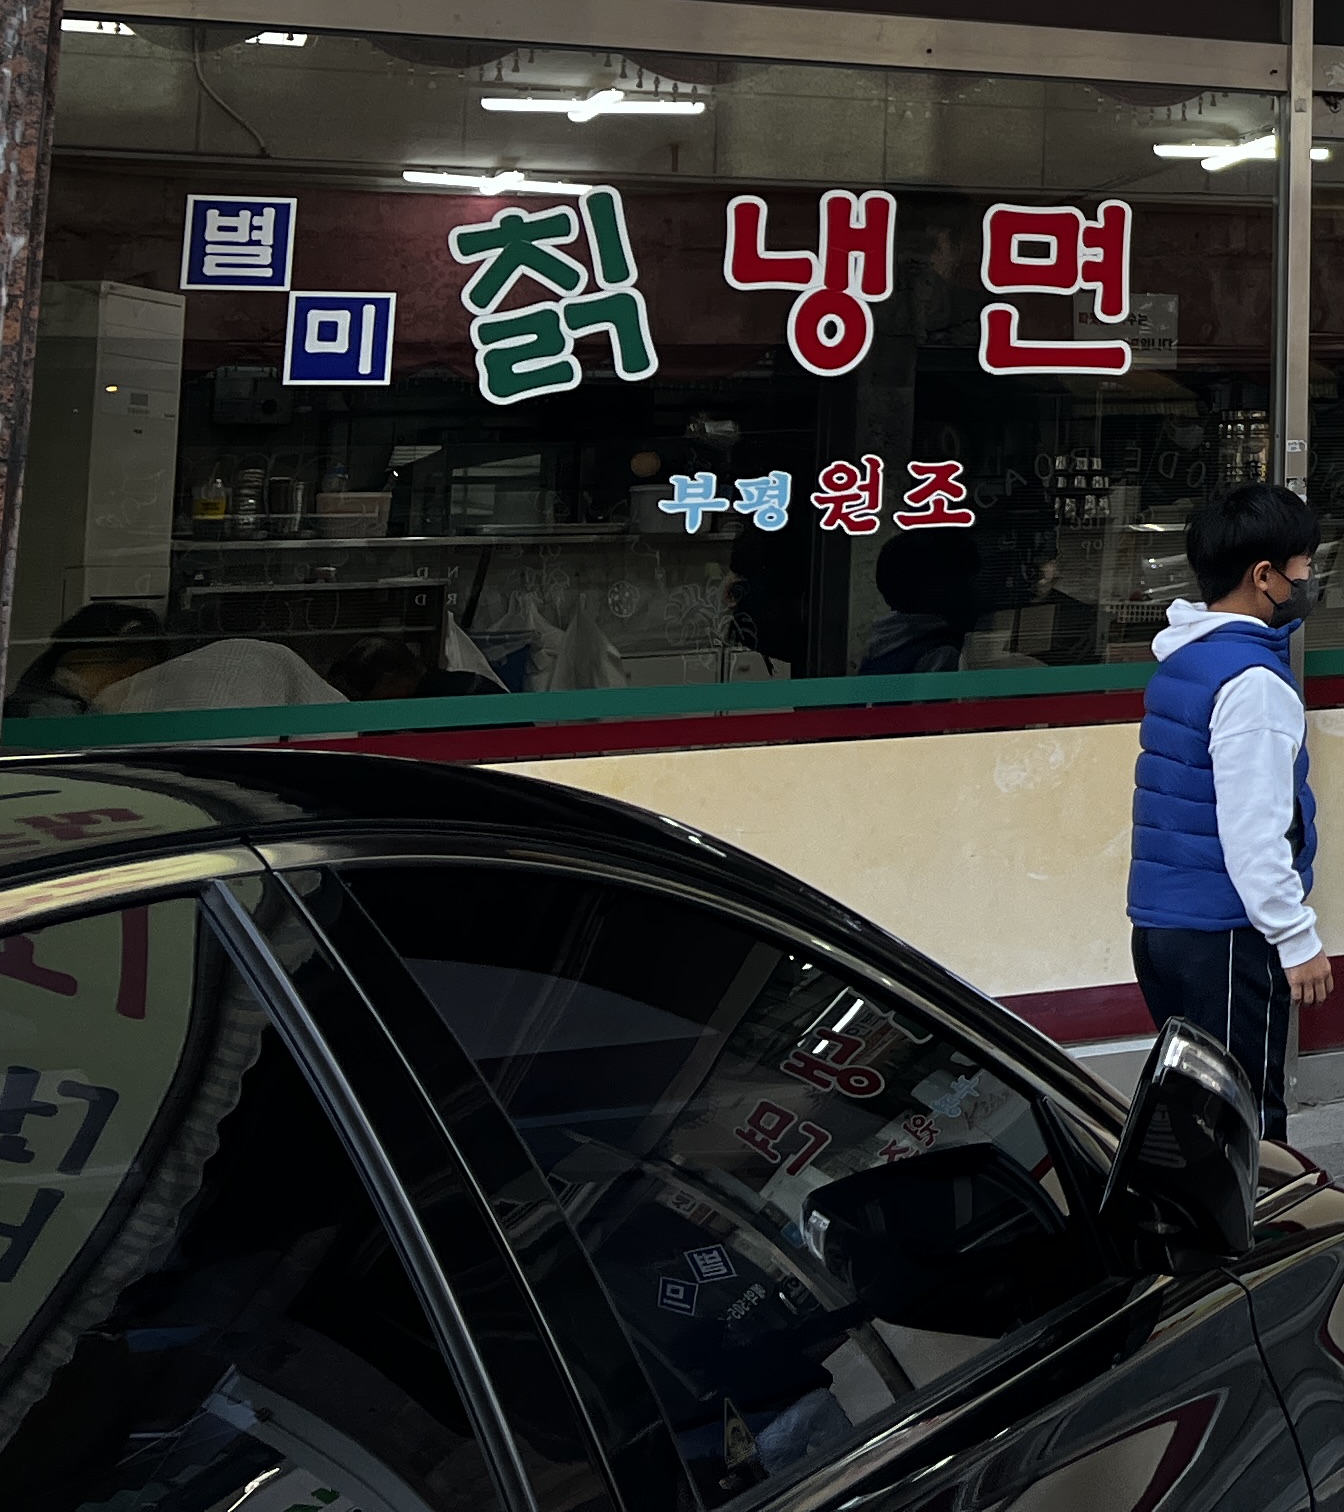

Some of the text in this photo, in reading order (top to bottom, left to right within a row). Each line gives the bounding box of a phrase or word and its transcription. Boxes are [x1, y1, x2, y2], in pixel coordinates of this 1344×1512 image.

[449, 185, 1132, 405] 칡냉면
[659, 471, 792, 534] 부평
[812, 454, 975, 536] 원조
